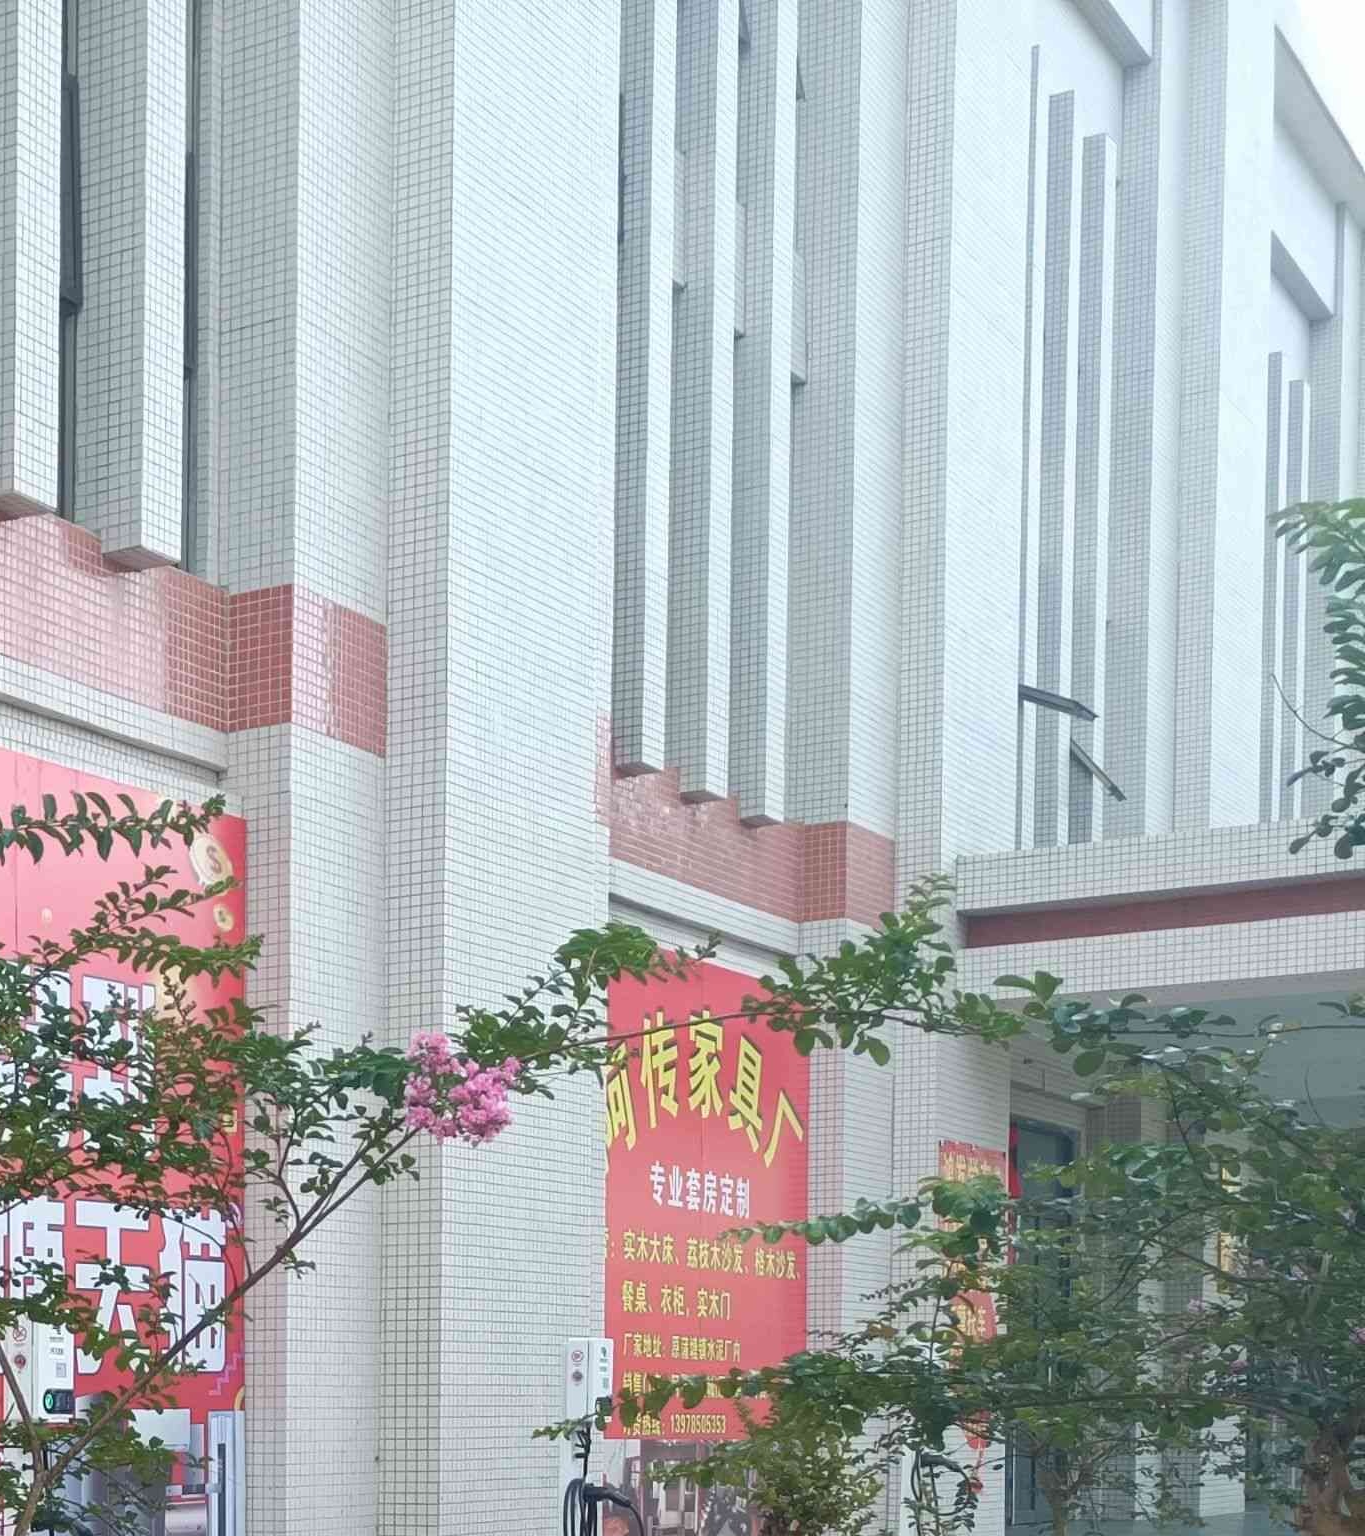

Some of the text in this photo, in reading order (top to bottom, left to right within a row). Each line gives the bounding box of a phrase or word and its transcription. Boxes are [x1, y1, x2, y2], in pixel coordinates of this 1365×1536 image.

[650, 1161, 750, 1218] 专业套房定制
